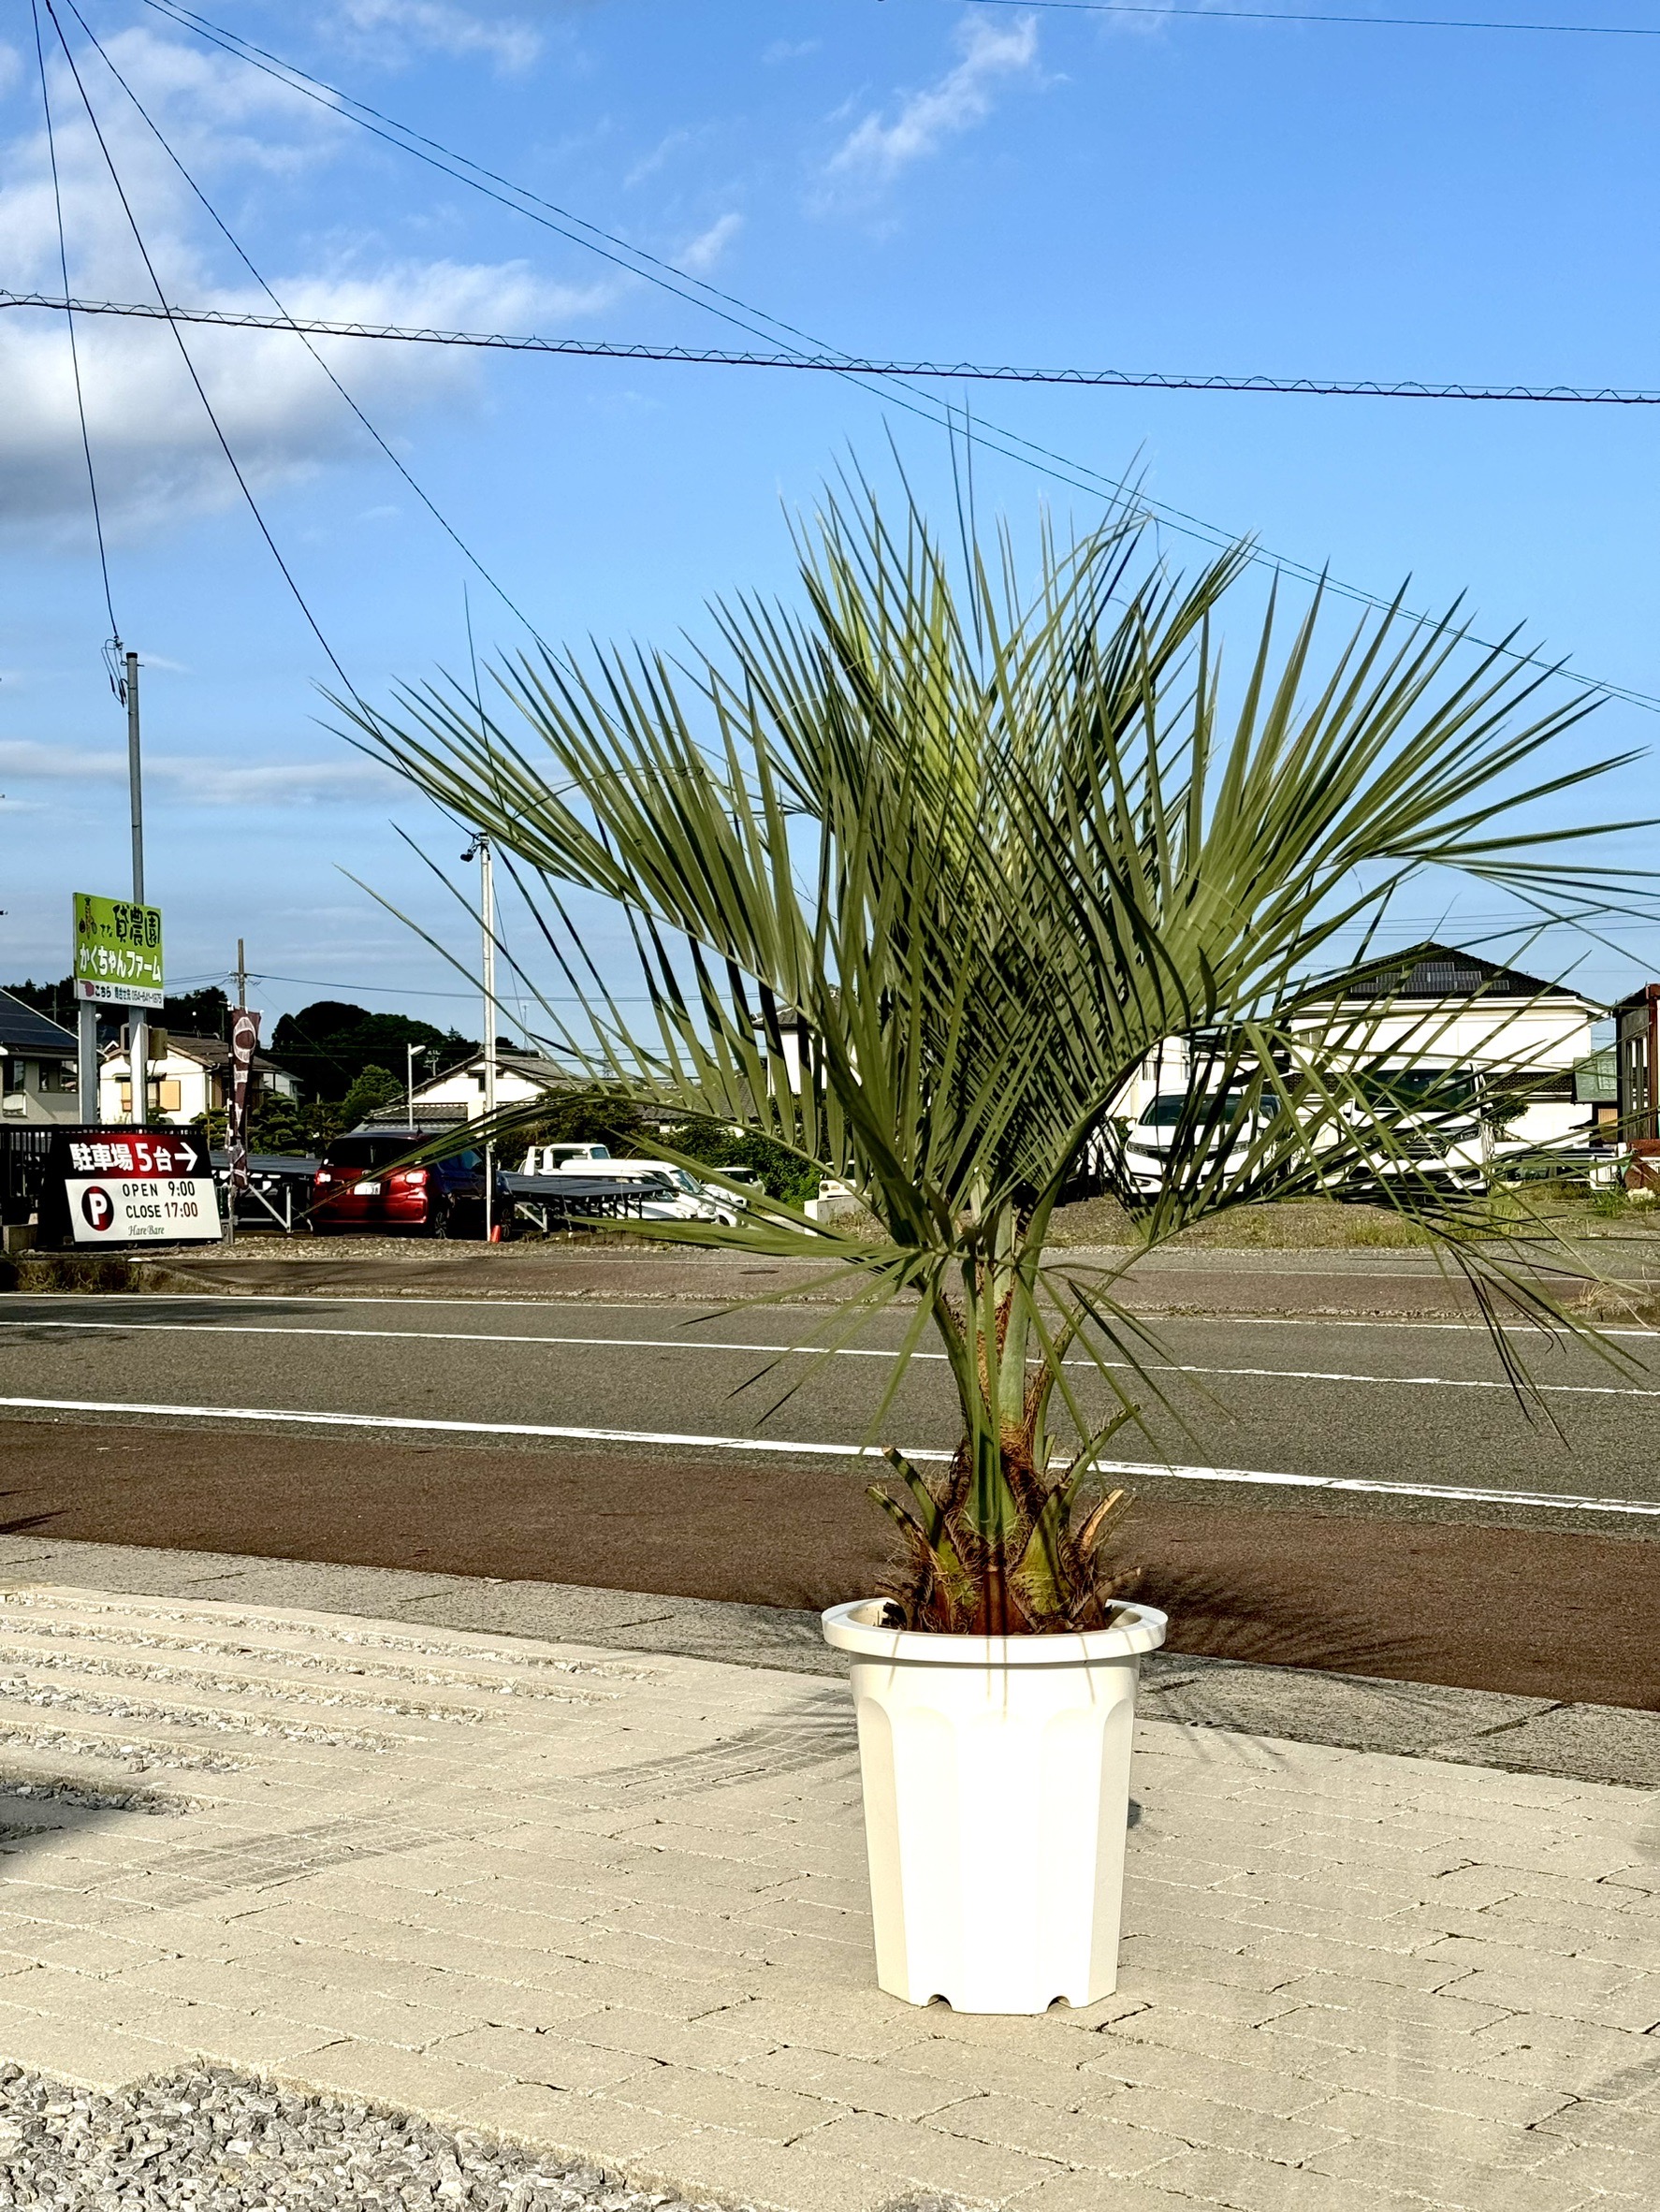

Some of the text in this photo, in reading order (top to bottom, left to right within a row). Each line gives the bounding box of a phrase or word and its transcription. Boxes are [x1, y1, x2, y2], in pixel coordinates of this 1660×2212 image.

[112, 904, 161, 948] 貸農園
[80, 942, 162, 982] かくちゃんファーム
[95, 985, 111, 998] こちら
[122, 1181, 196, 1197] OPEN 9:00
[88, 1192, 108, 1225] P
[125, 1201, 198, 1218] CLOSE 17:00
